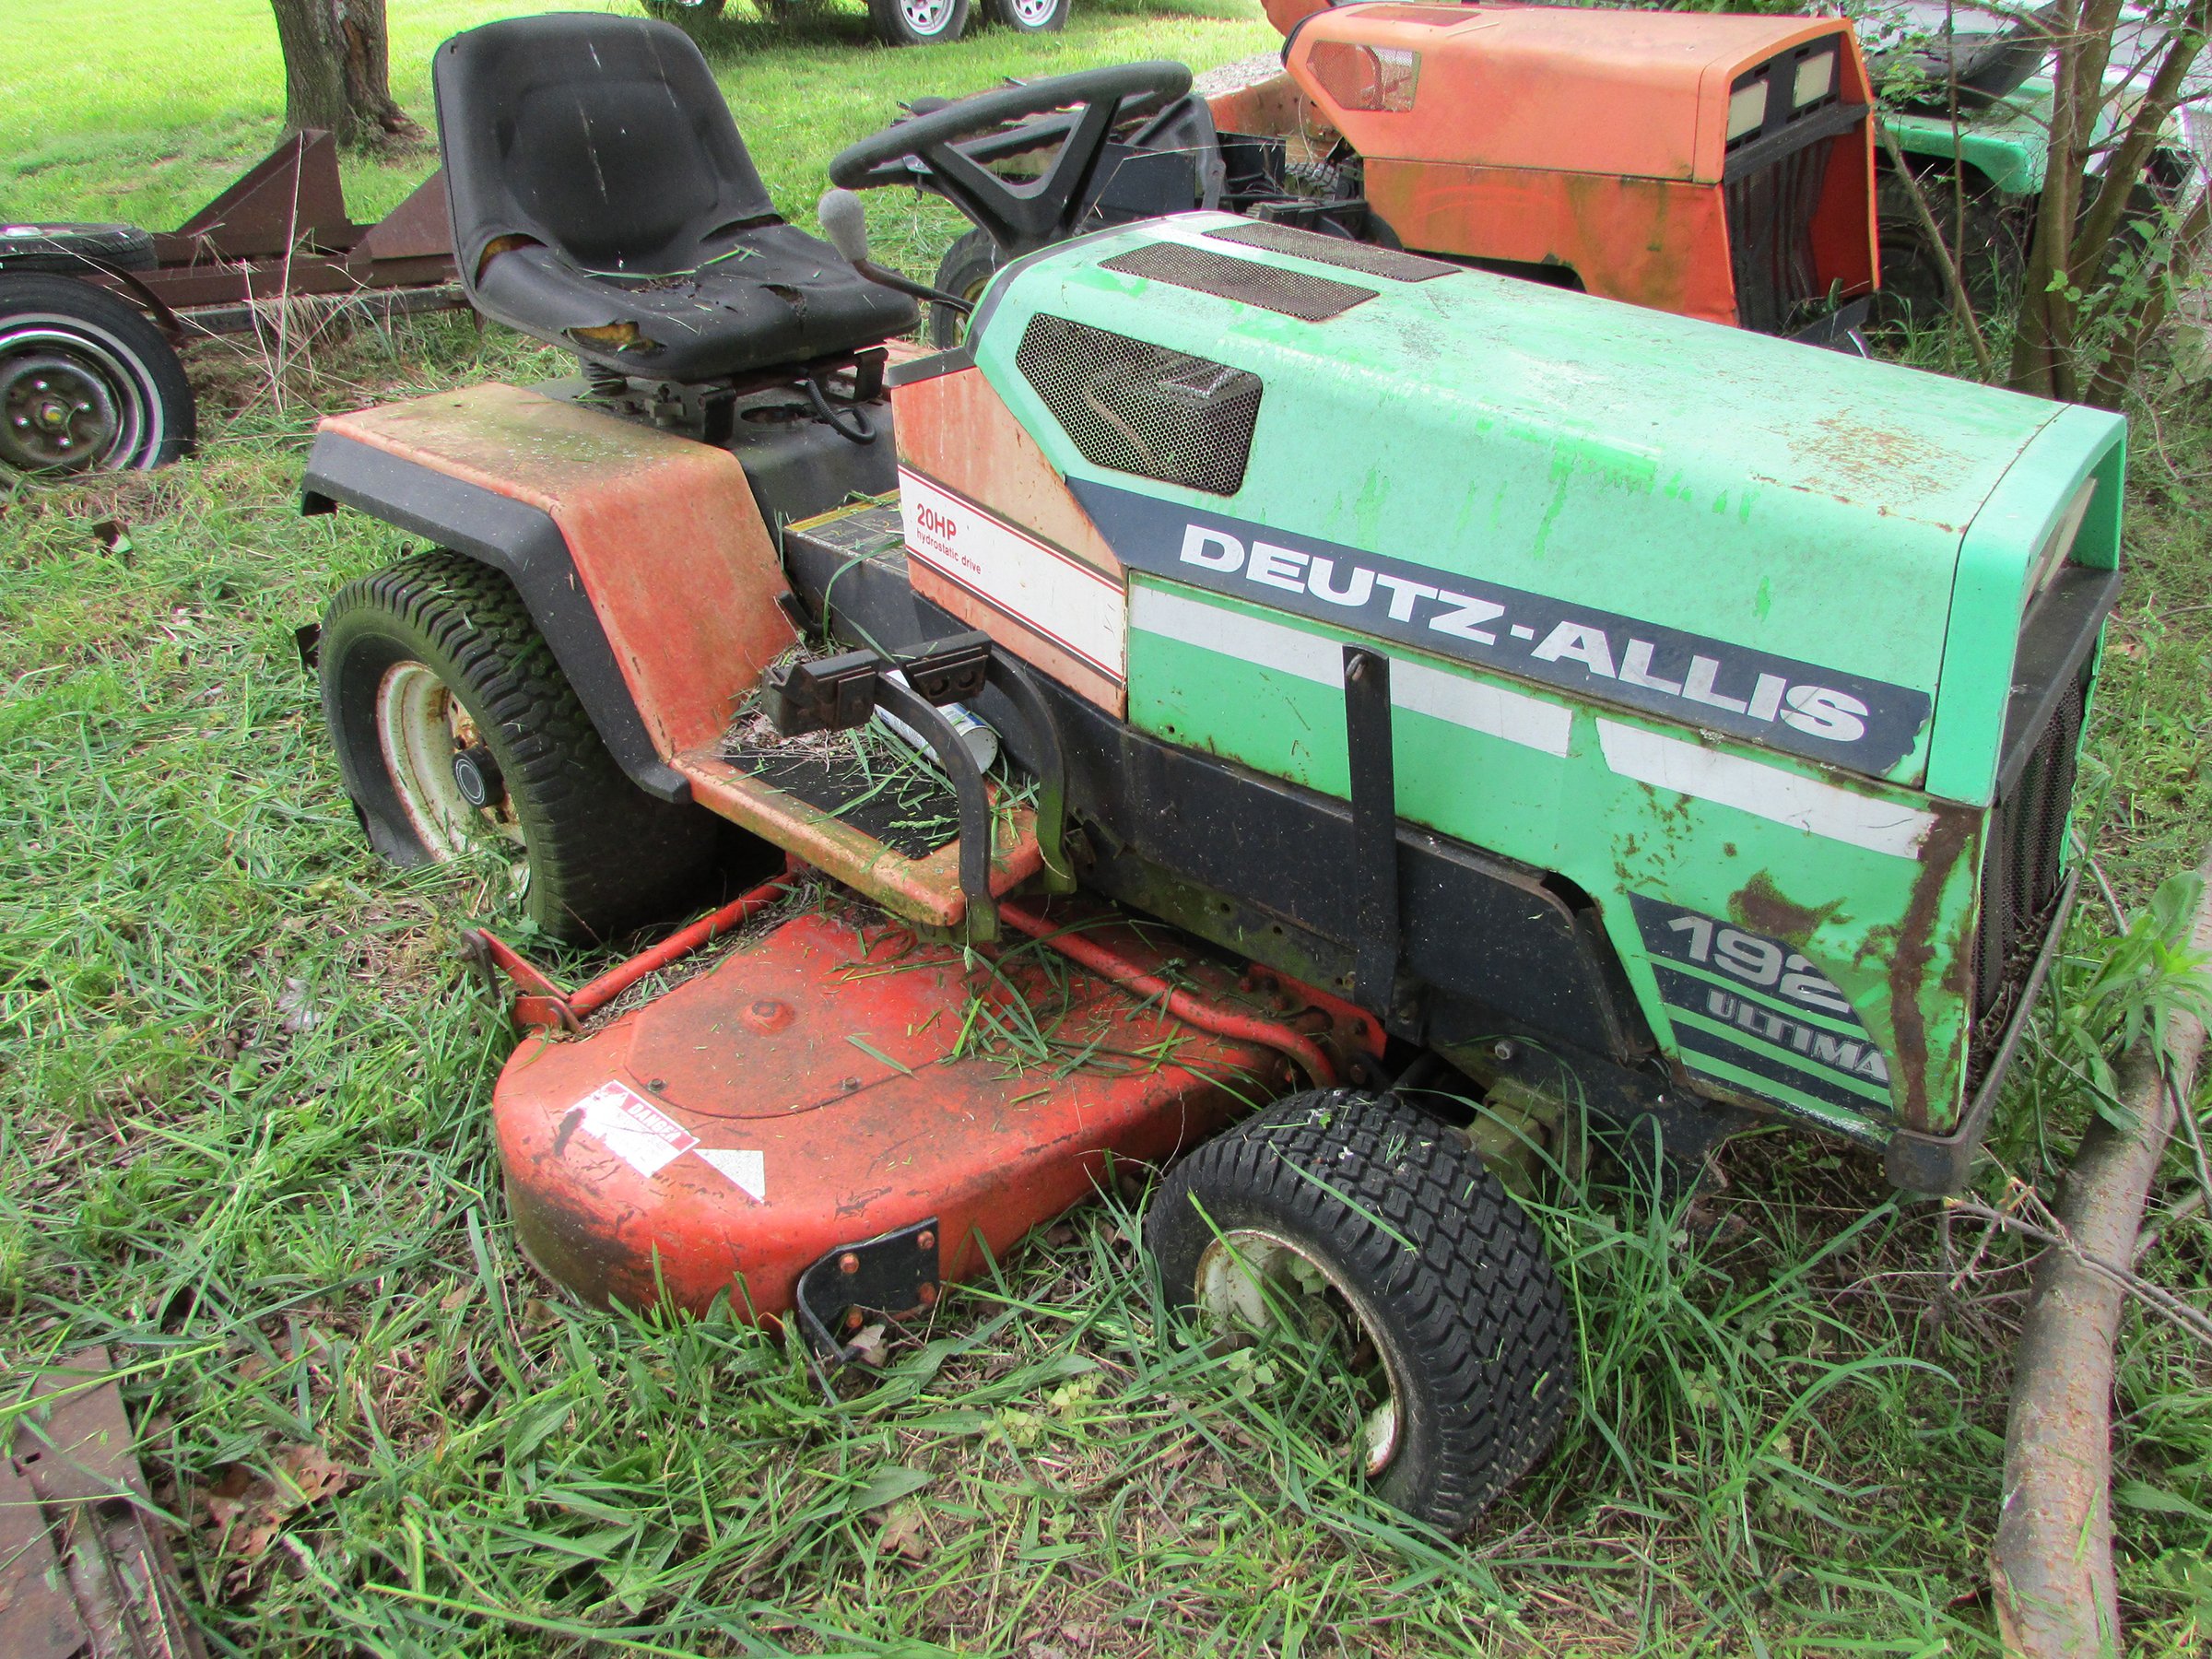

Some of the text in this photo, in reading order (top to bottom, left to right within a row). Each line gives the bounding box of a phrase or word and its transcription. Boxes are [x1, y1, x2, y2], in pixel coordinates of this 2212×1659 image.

[917, 503, 956, 541] 20HP
[917, 527, 982, 575] hydrostatic drive
[1180, 524, 1868, 742] DEUTZ-ALLIS
[1707, 988, 1889, 1082] ULTIMA
